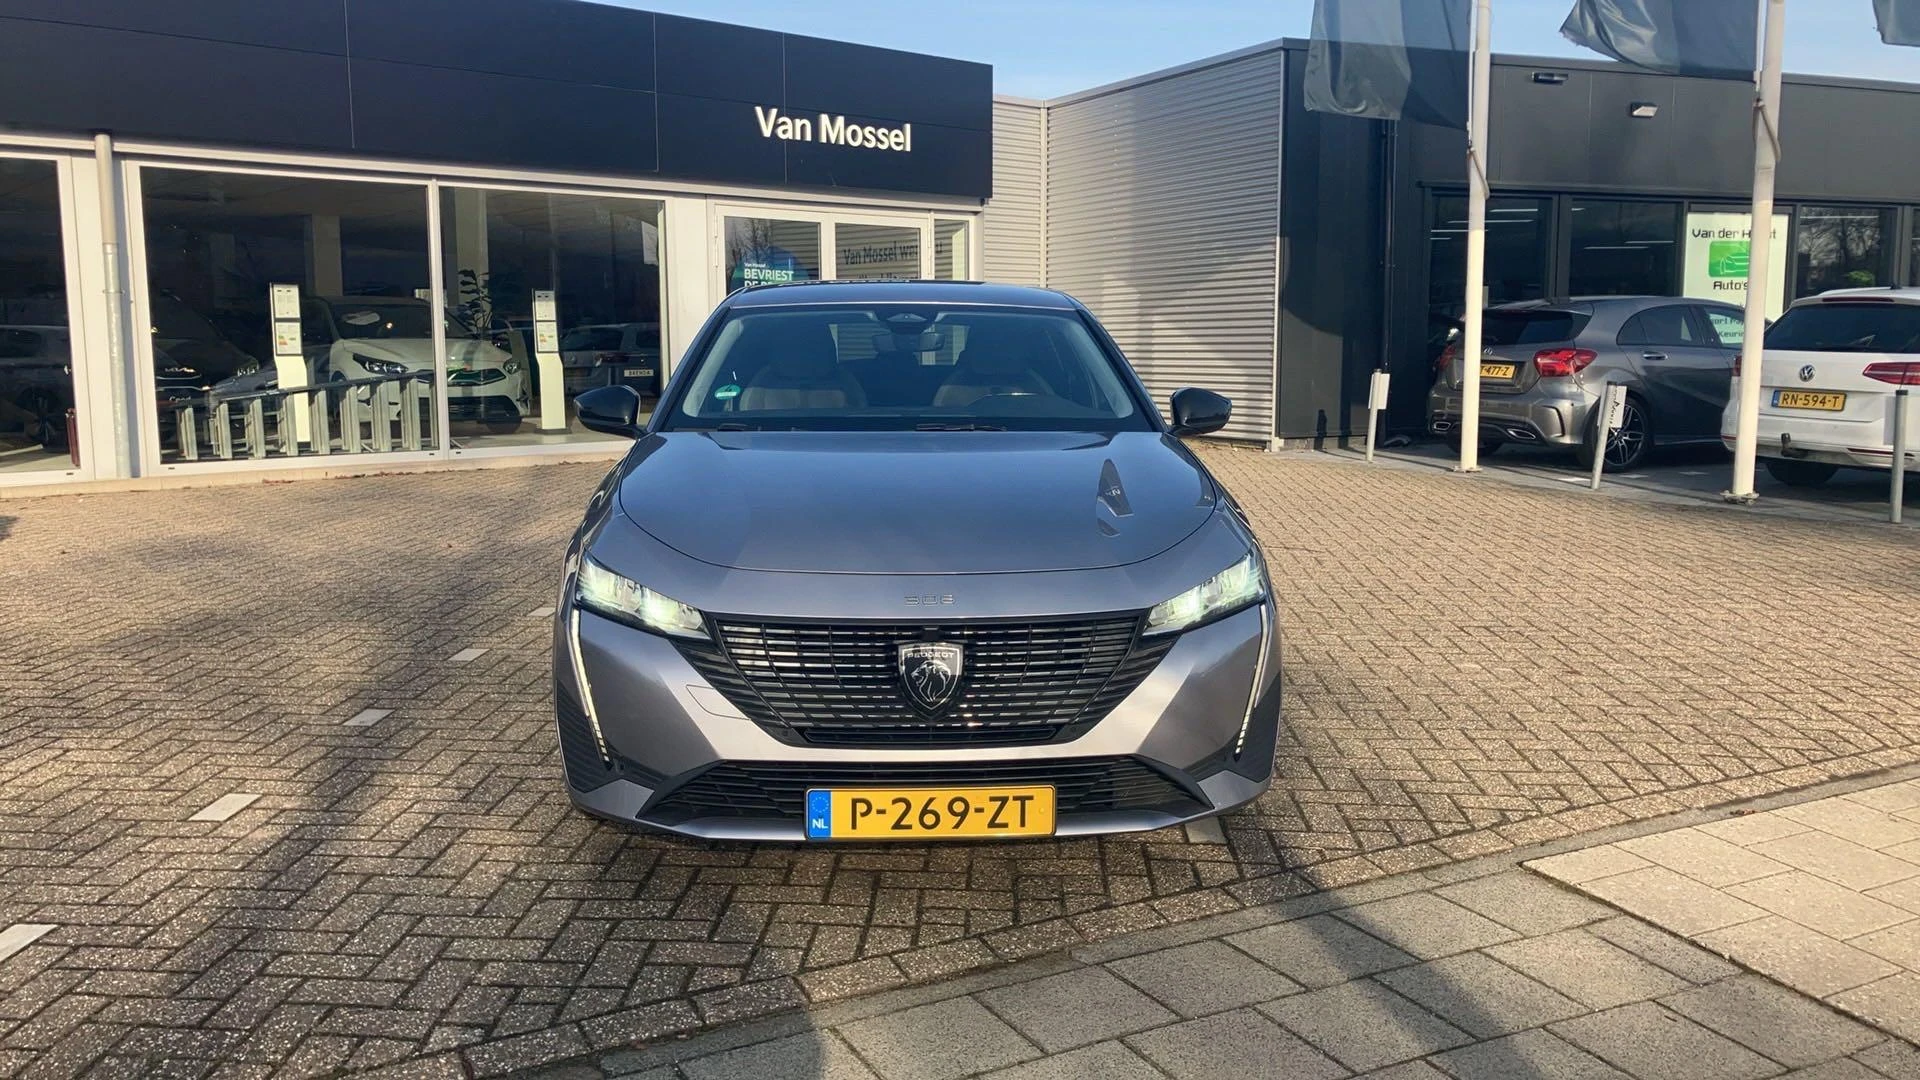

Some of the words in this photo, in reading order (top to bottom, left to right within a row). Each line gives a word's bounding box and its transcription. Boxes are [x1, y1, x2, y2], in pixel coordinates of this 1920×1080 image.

[755, 105, 812, 142] Van
[818, 113, 911, 152] Mossel
[1692, 228, 1715, 239] Van
[1718, 228, 1739, 239] der
[843, 247, 862, 265] Van
[863, 241, 898, 264] Mossel
[744, 268, 794, 281] BEVRIEST
[1713, 280, 1748, 291] Auto's
[1480, 365, 1510, 377] T-477-Z
[1781, 393, 1840, 408] RN-594-T
[903, 594, 956, 607] 308
[907, 651, 955, 659] PEUGEOT
[851, 795, 1034, 830] P-269-ZT
[812, 819, 828, 829] NL
